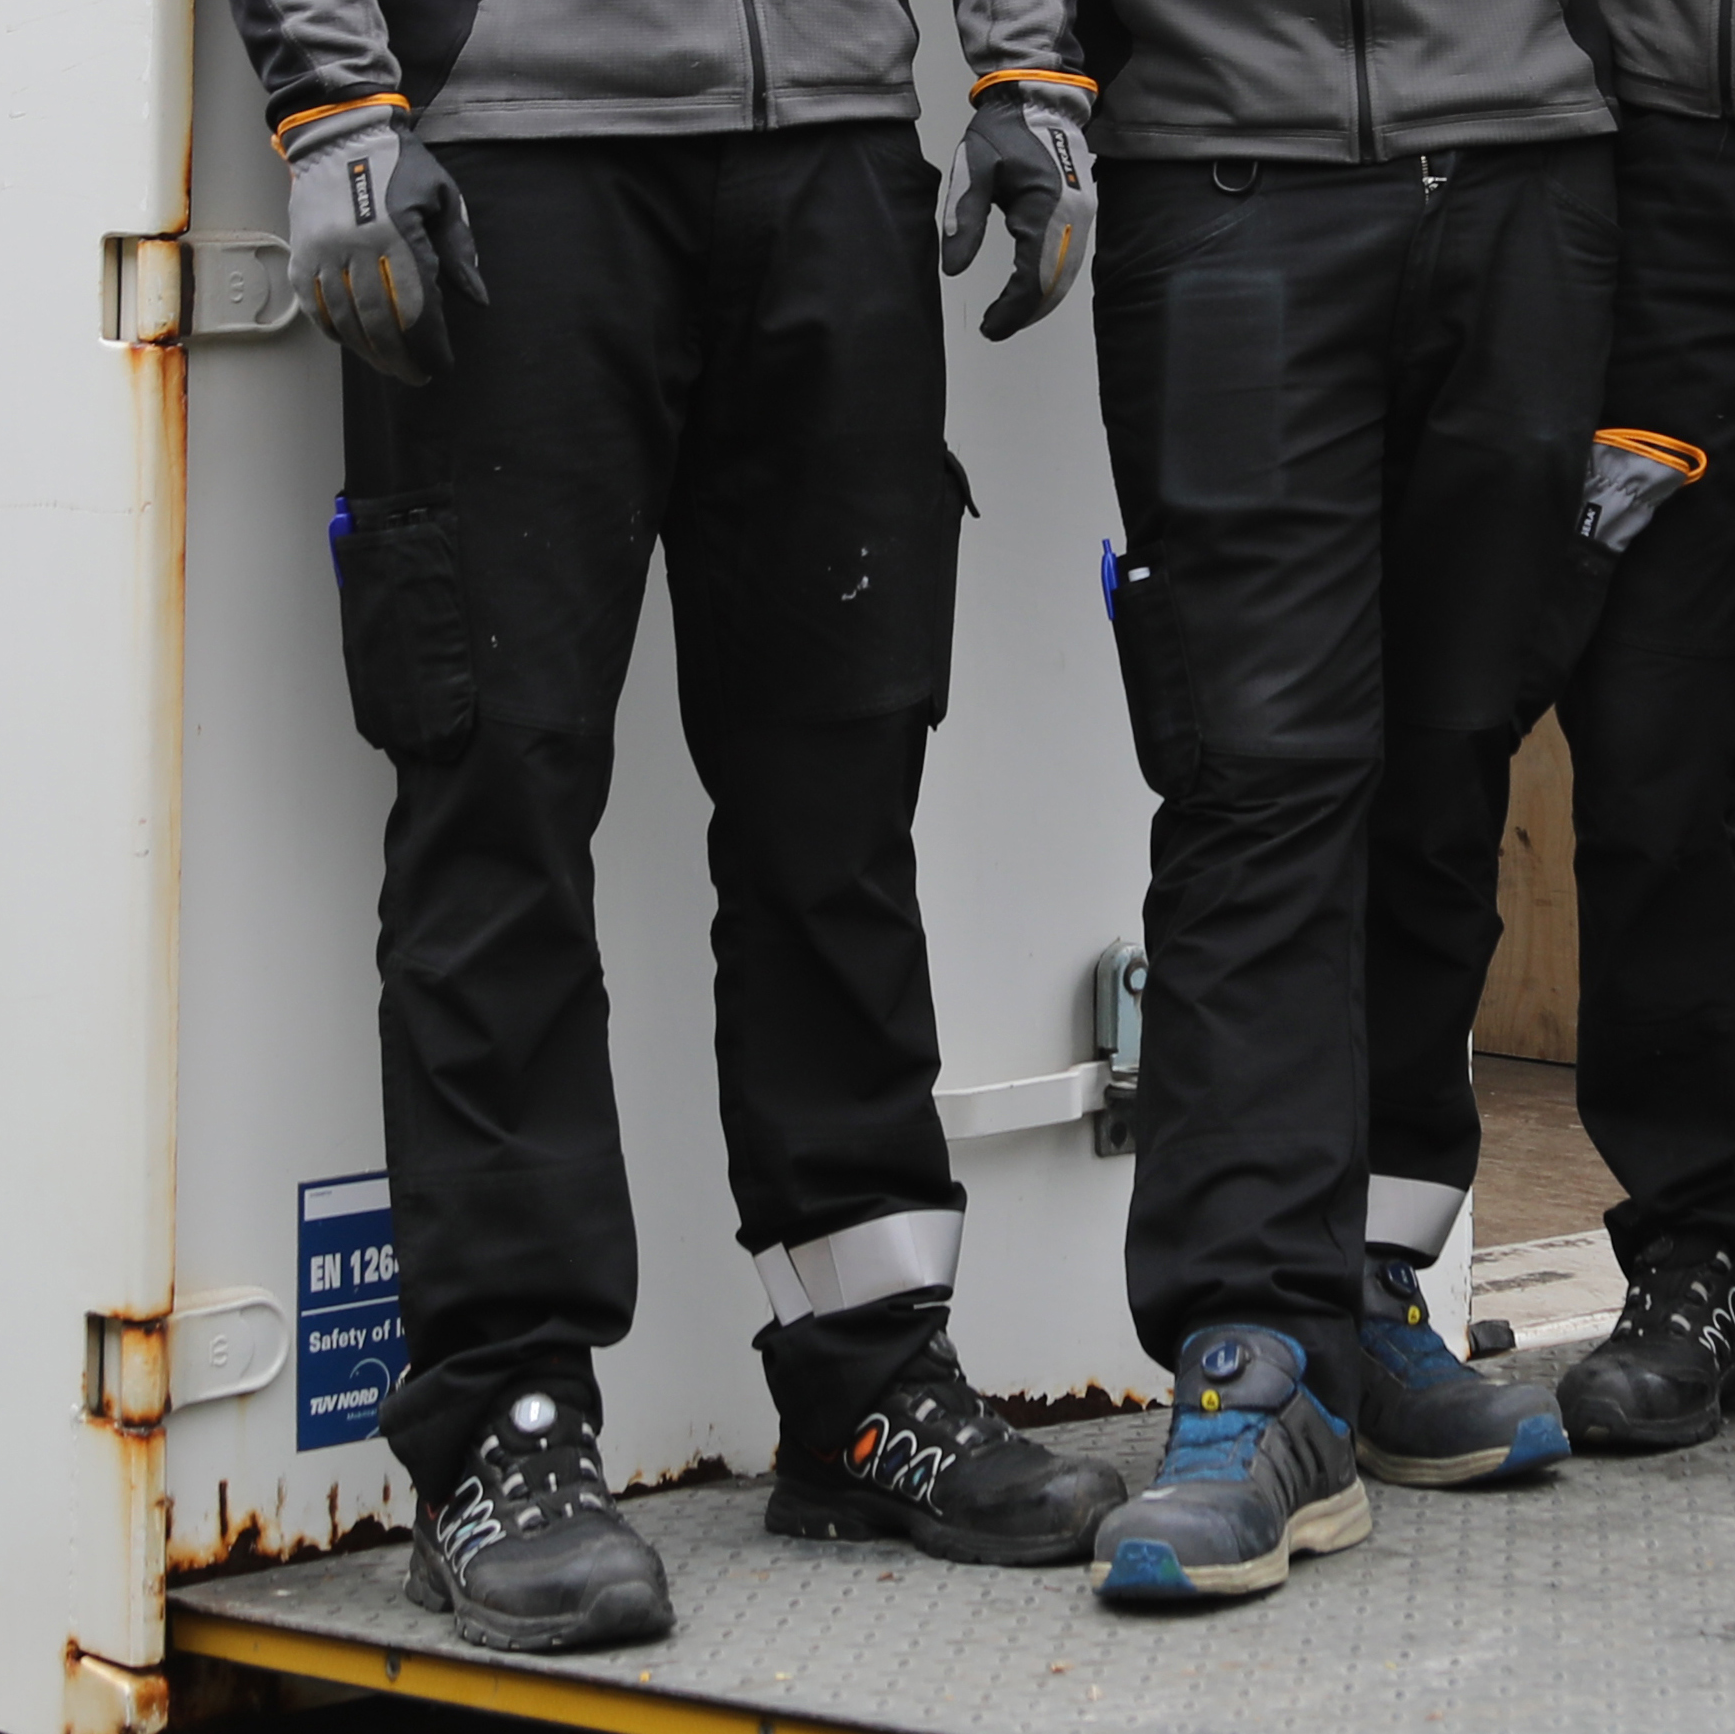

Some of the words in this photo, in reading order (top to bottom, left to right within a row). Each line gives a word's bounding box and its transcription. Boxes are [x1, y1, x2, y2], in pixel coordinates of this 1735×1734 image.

[310, 1252, 342, 1293] EN
[309, 1327, 367, 1354] Safety
[372, 1318, 391, 1343] of
[337, 1386, 379, 1411] NORD
